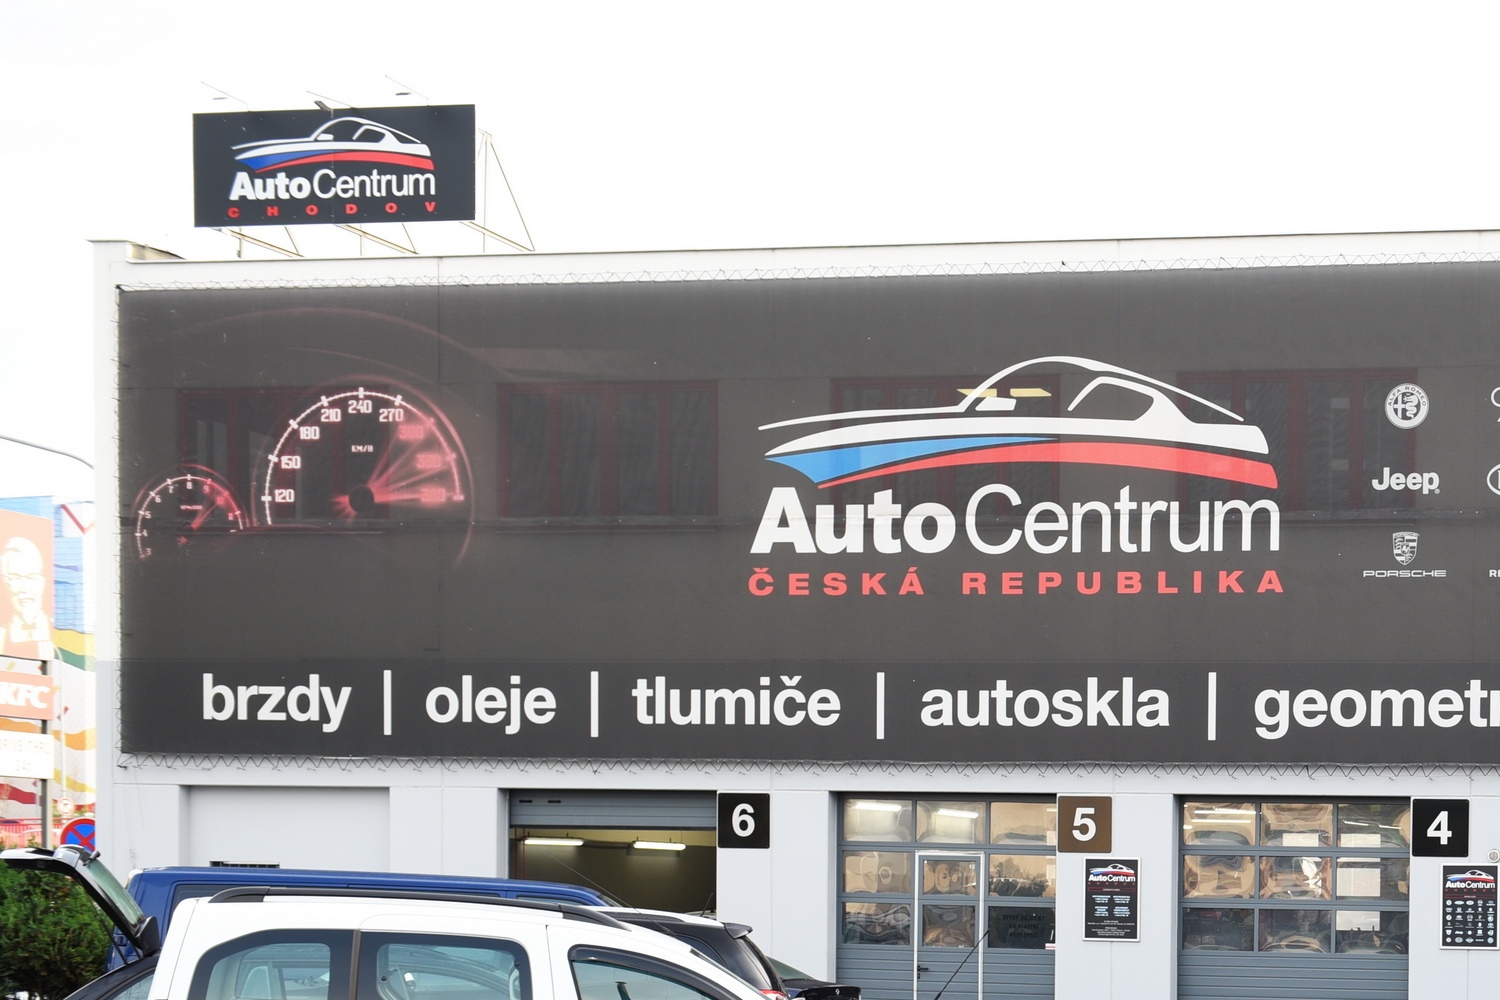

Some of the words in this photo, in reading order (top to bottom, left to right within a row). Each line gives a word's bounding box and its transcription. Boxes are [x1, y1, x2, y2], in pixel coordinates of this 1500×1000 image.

[228, 168, 436, 200] AutoCentrum
[227, 201, 436, 218] CHODOV
[348, 400, 372, 413] 240
[321, 408, 341, 422] 210
[379, 408, 404, 422] 270
[300, 426, 320, 440] 180
[281, 455, 301, 469] 150
[275, 489, 294, 502] 120
[749, 483, 1281, 555] AutoCentrum
[1363, 569, 1447, 578] PORSCHE
[748, 567, 925, 596] ČESKÁ
[961, 569, 1284, 595] REPUBLIKA
[202, 672, 352, 733] brzdy
[425, 675, 557, 734] oleje
[631, 675, 841, 726] tlumiče
[920, 677, 1171, 727] autoskla
[731, 803, 756, 838] 6
[1071, 807, 1097, 842] 5
[1426, 810, 1453, 846] 4
[1088, 874, 1136, 882] AutoCentrum
[1445, 881, 1495, 889] AutoCentrum
